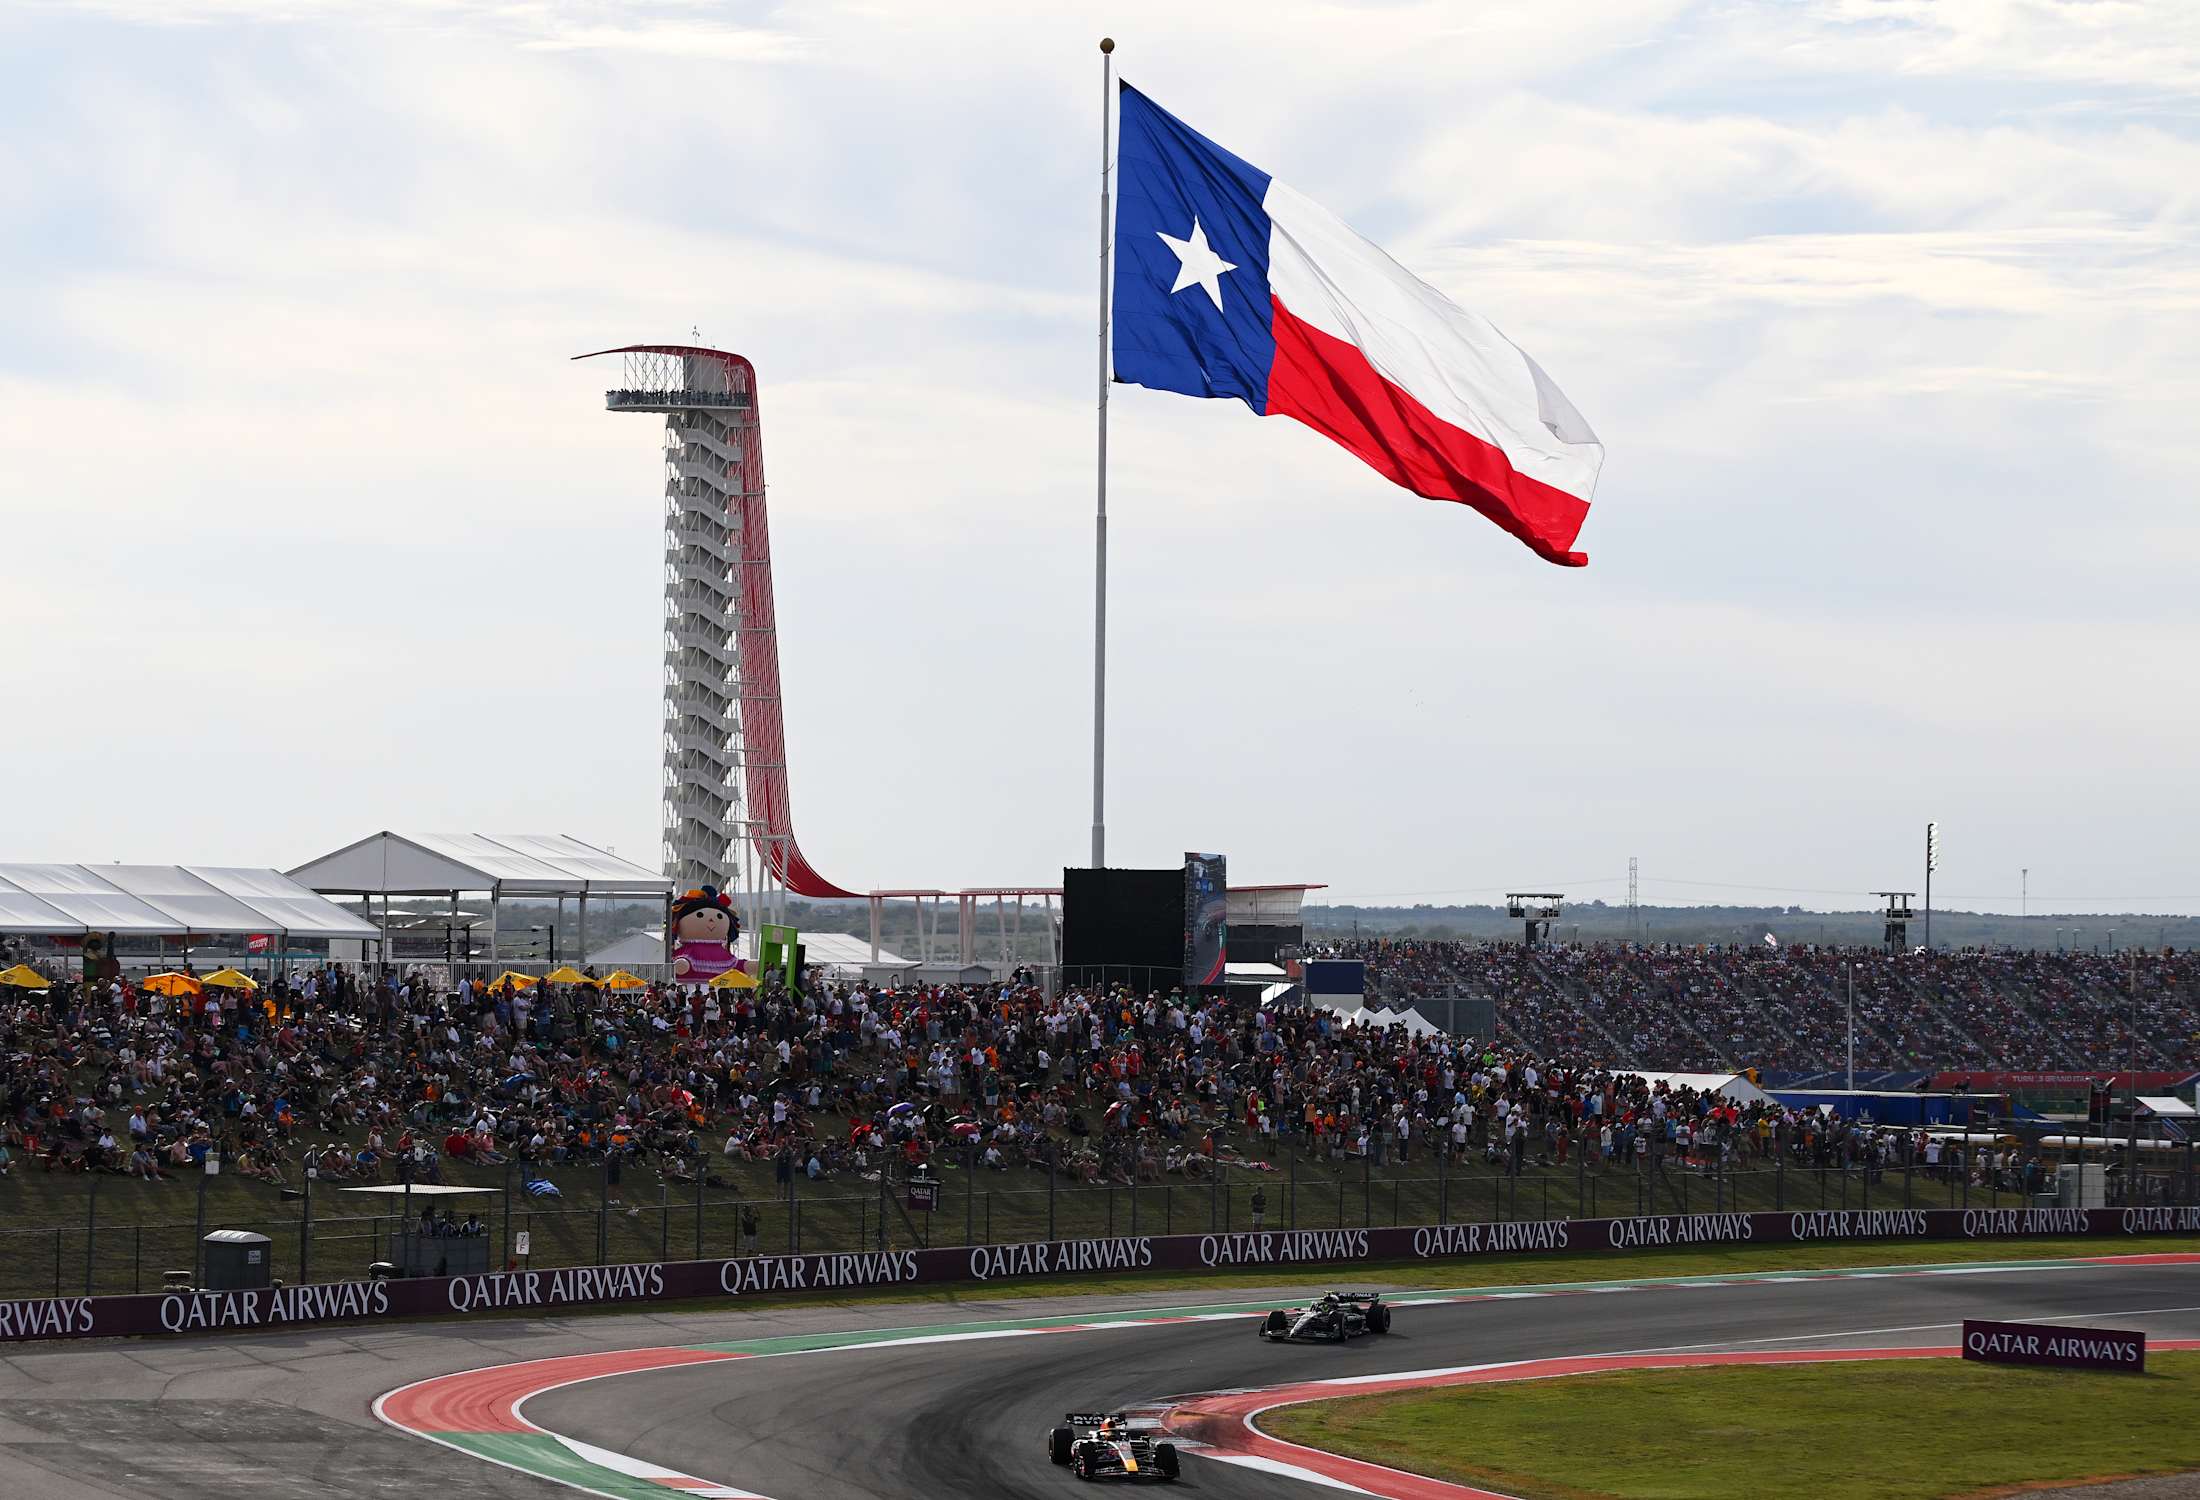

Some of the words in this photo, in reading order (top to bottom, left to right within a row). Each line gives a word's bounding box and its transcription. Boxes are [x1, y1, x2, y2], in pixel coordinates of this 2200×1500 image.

[911, 1187, 931, 1196] QATAR
[1609, 1216, 1671, 1248] QATAR
[1676, 1213, 1752, 1242] AIRWAYS
[1791, 1211, 1850, 1240] QATAR
[1854, 1209, 1927, 1237] AIRWAYS
[1963, 1208, 2017, 1237] QATAR
[2021, 1208, 2090, 1233] AIRWAYS
[2122, 1208, 2173, 1234] QATAR
[1200, 1233, 1273, 1267] QATAR
[1280, 1230, 1369, 1261] AIRWAYS
[1414, 1225, 1480, 1257] QATAR
[1486, 1221, 1568, 1251] AIRWAYS
[720, 1257, 806, 1295] QATAR
[813, 1250, 918, 1286] AIRWAYS
[970, 1243, 1049, 1280] QATAR
[1056, 1237, 1152, 1271] AIRWAYS
[448, 1272, 541, 1312] QATAR
[549, 1264, 664, 1303] AIRWAYS
[161, 1291, 260, 1332] QATAR
[268, 1282, 388, 1321] AIRWAYS
[1968, 1332, 2040, 1355] QATAR
[2045, 1338, 2137, 1362] AIRWAYS
